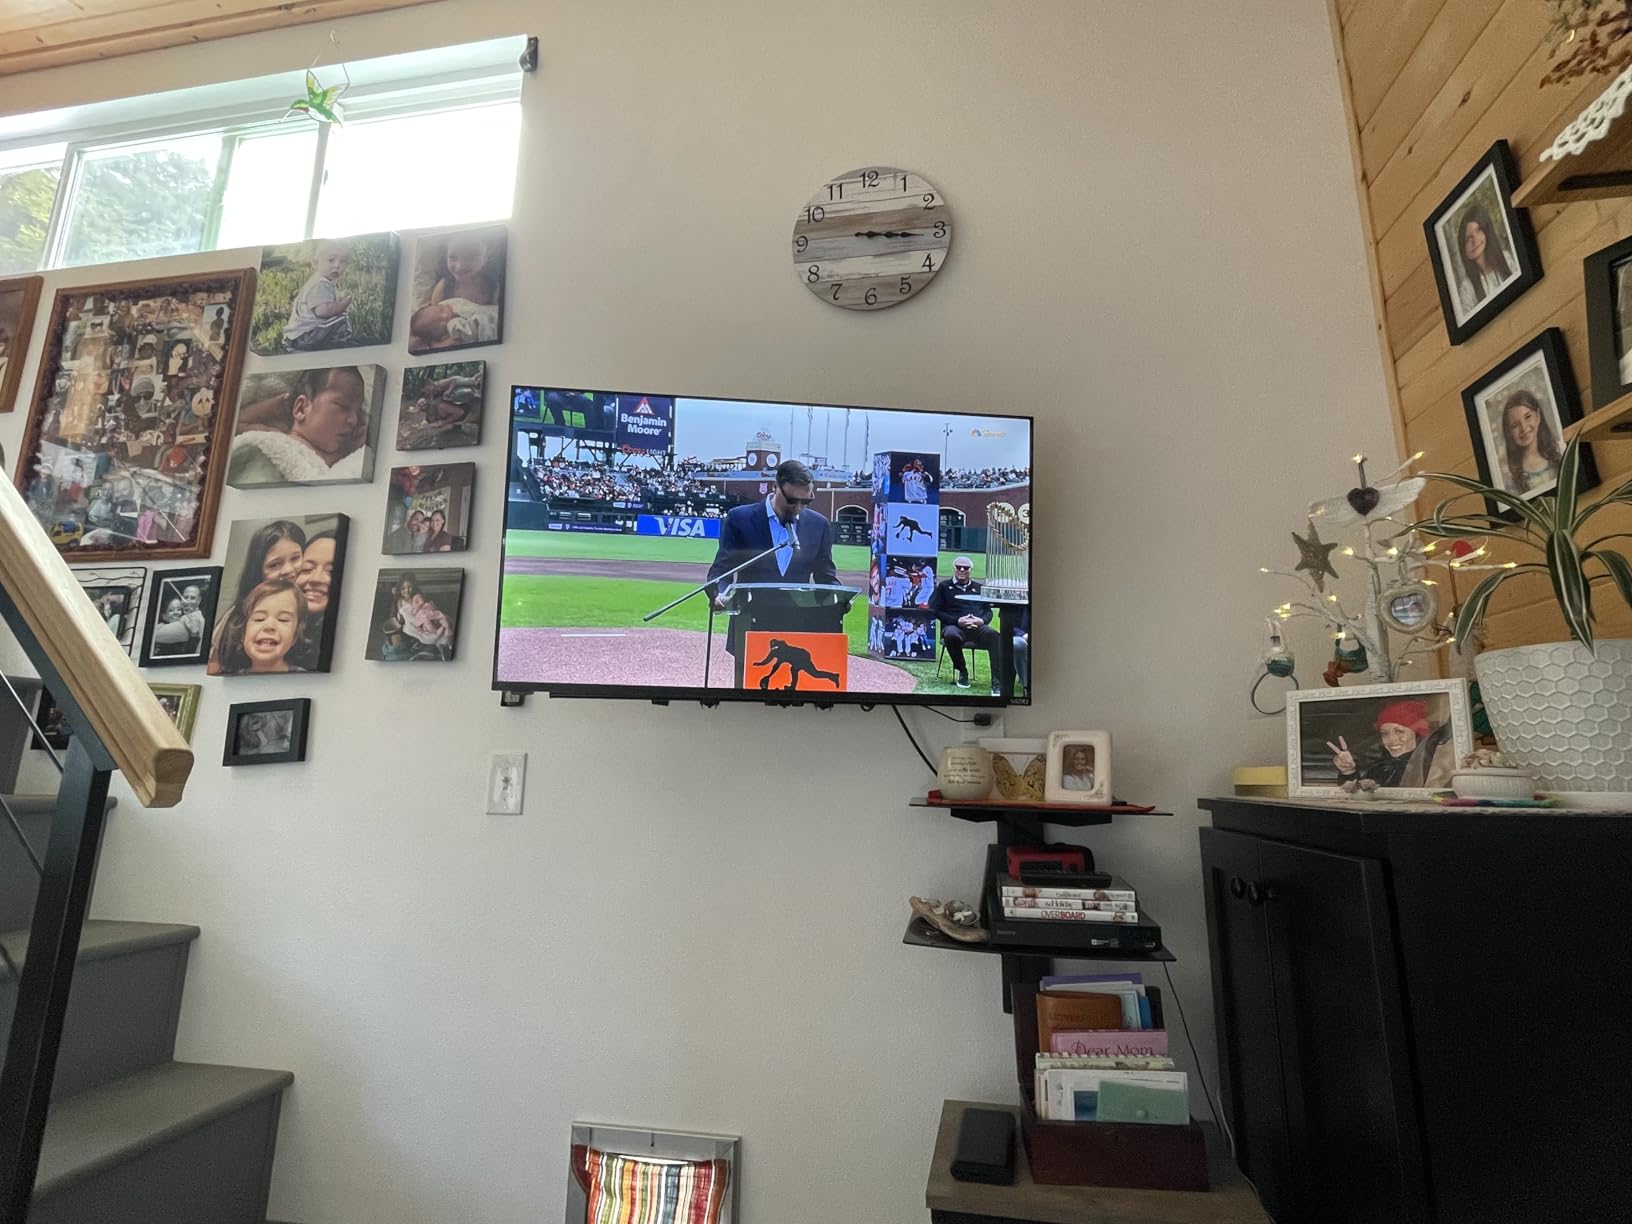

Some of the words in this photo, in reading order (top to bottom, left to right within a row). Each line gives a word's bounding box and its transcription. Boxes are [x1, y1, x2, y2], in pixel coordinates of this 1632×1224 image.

[859, 170, 880, 189] 12
[900, 175, 908, 192] 1
[827, 184, 843, 200] 11
[922, 193, 935, 211] 2
[805, 206, 825, 223] 10
[933, 221, 946, 238] 3
[796, 236, 808, 253] 9
[921, 253, 935, 272] 4
[807, 264, 820, 283] 8
[830, 283, 842, 301] 7
[899, 276, 912, 294] 5
[864, 288, 877, 305] 6
[621, 413, 667, 427] Benjamin
[627, 424, 660, 436] Moore
[646, 448, 666, 456] LIGHT
[654, 516, 706, 537] VISA
[1041, 910, 1087, 920] OVERBOARD
[1071, 1040, 1111, 1056] Dear
[1117, 1044, 1153, 1056] Mom
